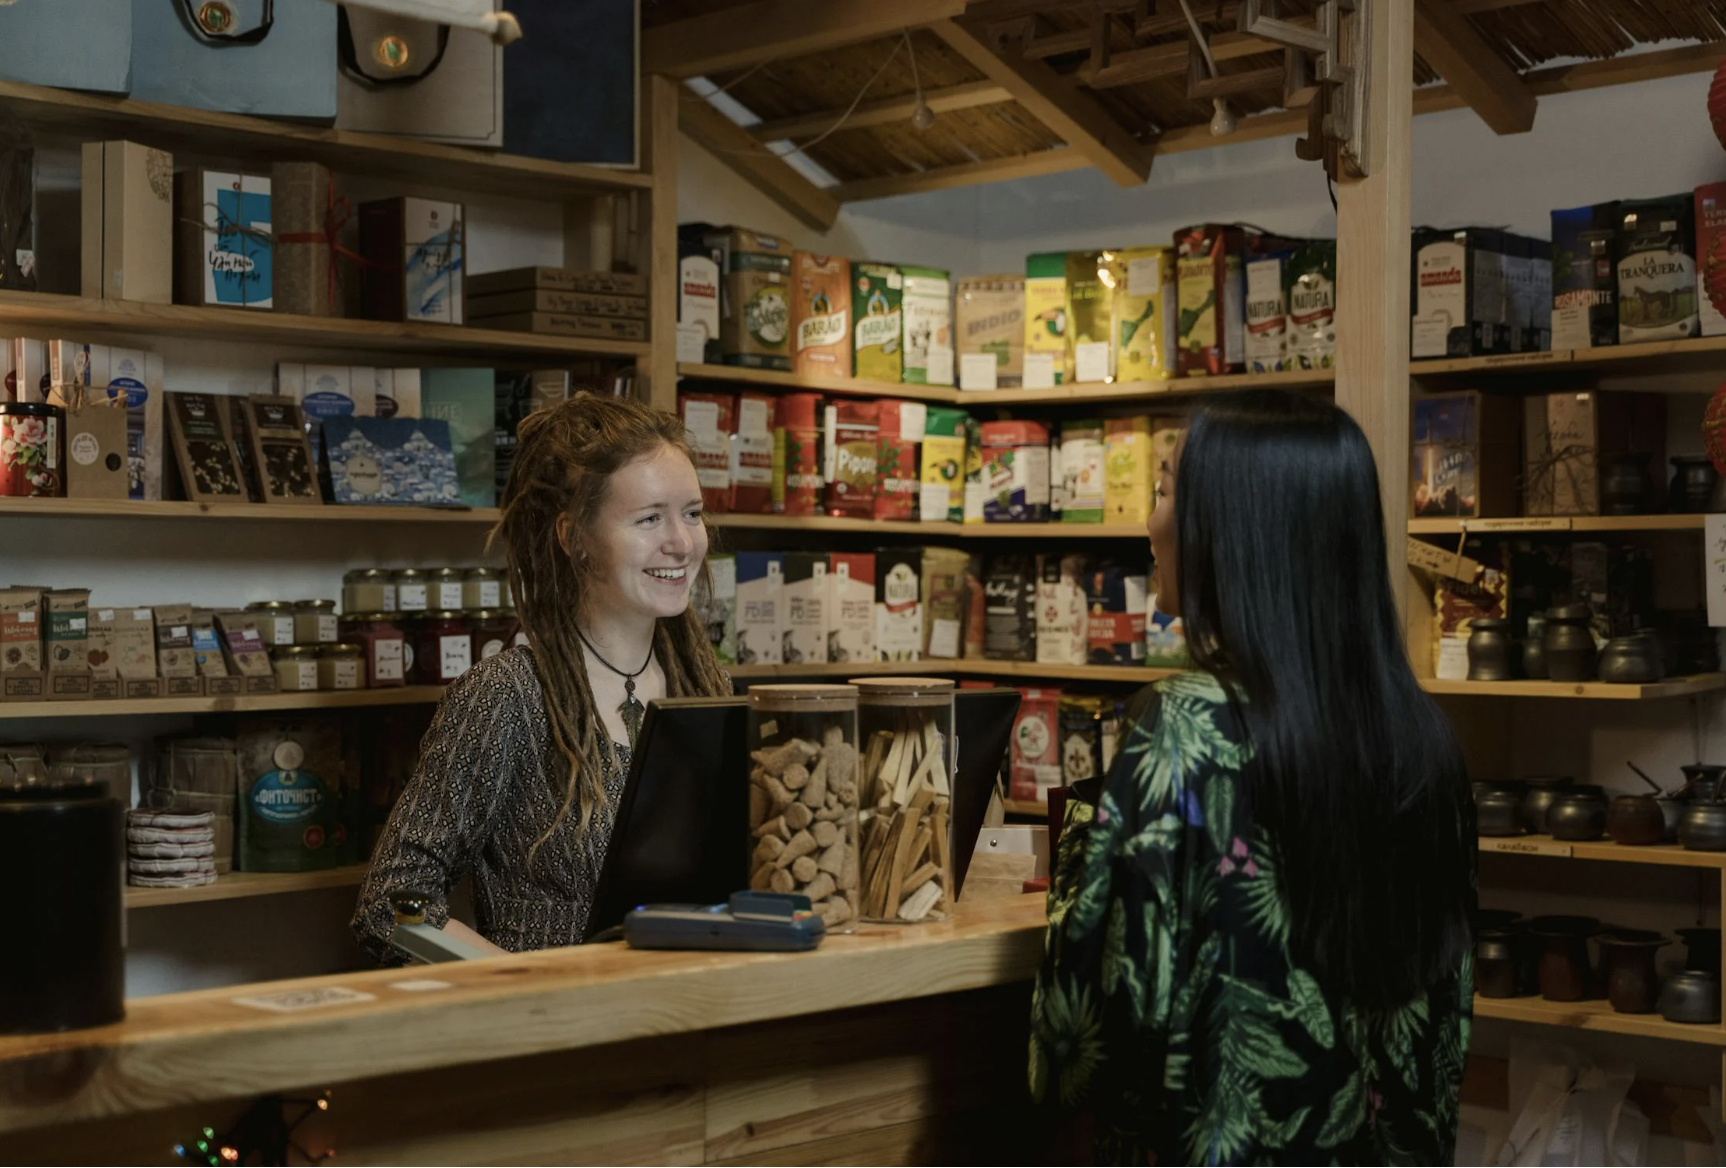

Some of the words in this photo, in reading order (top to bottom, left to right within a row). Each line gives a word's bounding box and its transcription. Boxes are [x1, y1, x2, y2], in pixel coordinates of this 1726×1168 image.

[1644, 257, 1656, 265] LA
[1620, 263, 1684, 280] TRANQUERA
[1294, 291, 1328, 309] NATURA
[1555, 289, 1613, 309] ROSAMONTE
[1248, 300, 1281, 318] NATURA
[968, 310, 1022, 336] INDIO
